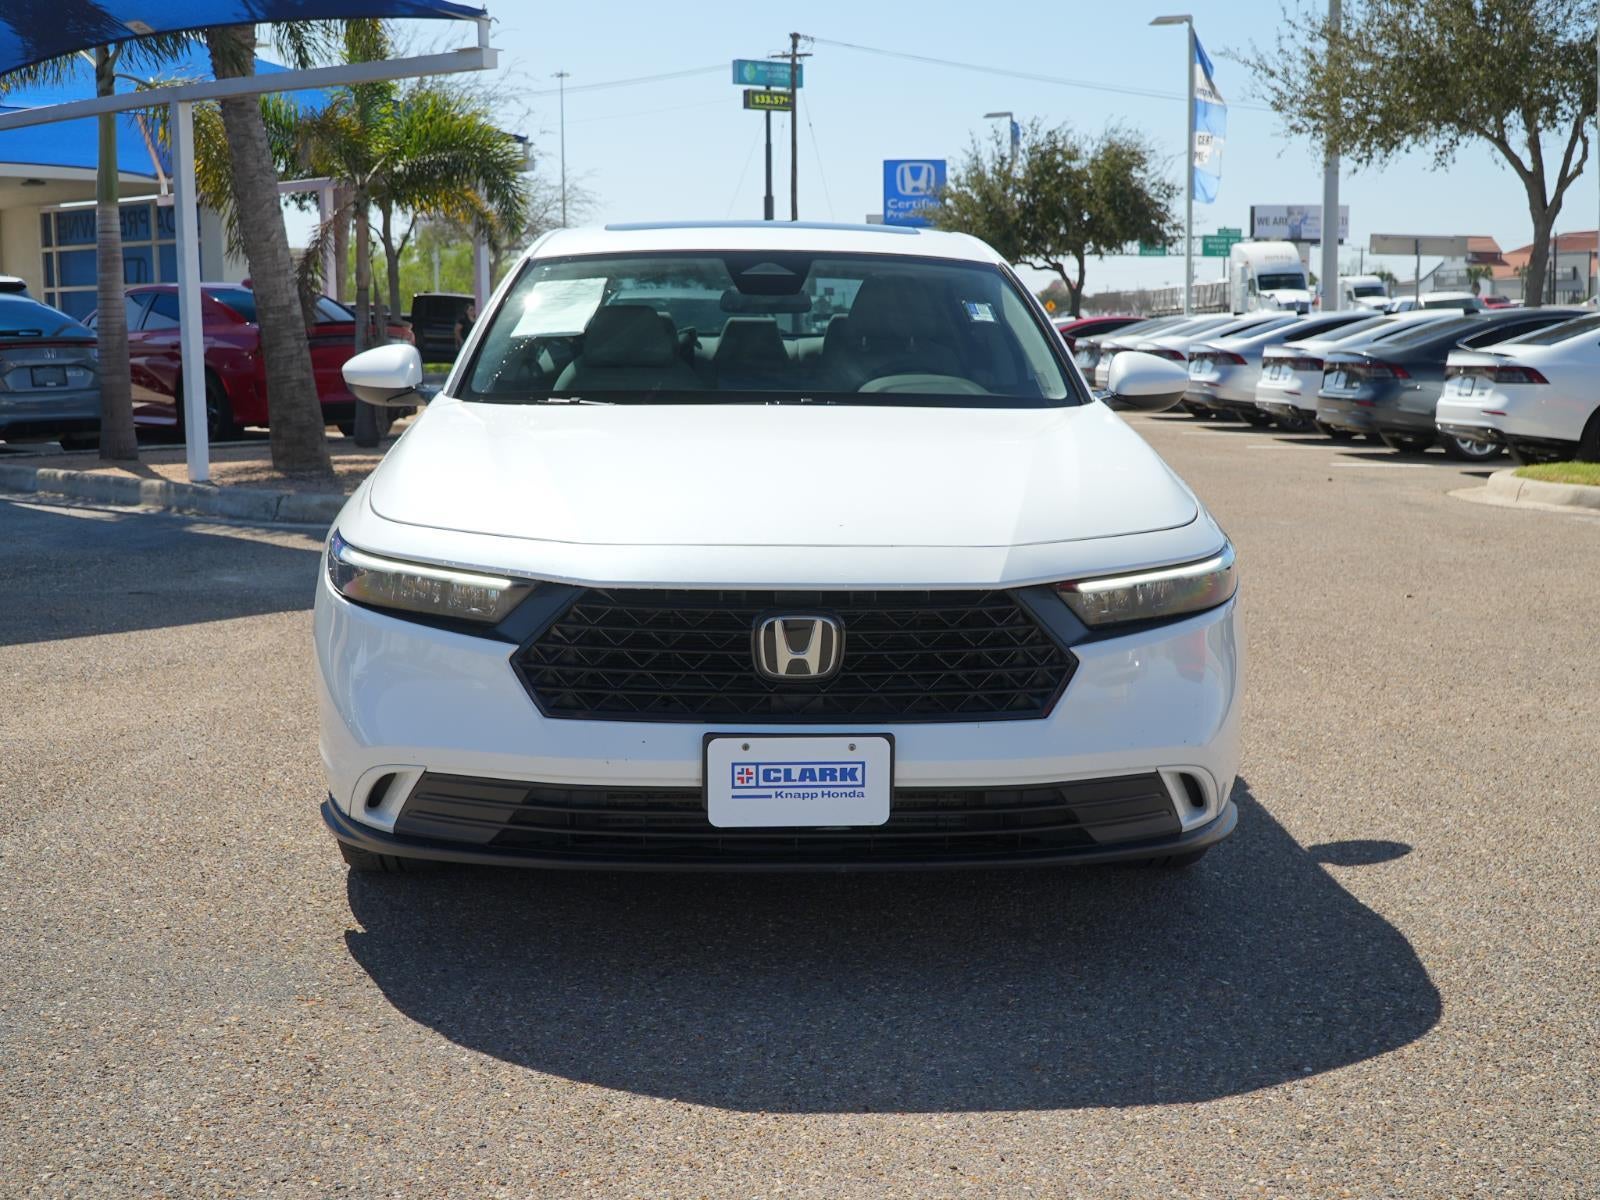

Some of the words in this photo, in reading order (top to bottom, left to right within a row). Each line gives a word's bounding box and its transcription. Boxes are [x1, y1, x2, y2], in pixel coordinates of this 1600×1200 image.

[1257, 216, 1270, 225] WE
[762, 767, 859, 783] CLARK
[774, 790, 818, 801] Knapp
[821, 789, 865, 799] Honda
